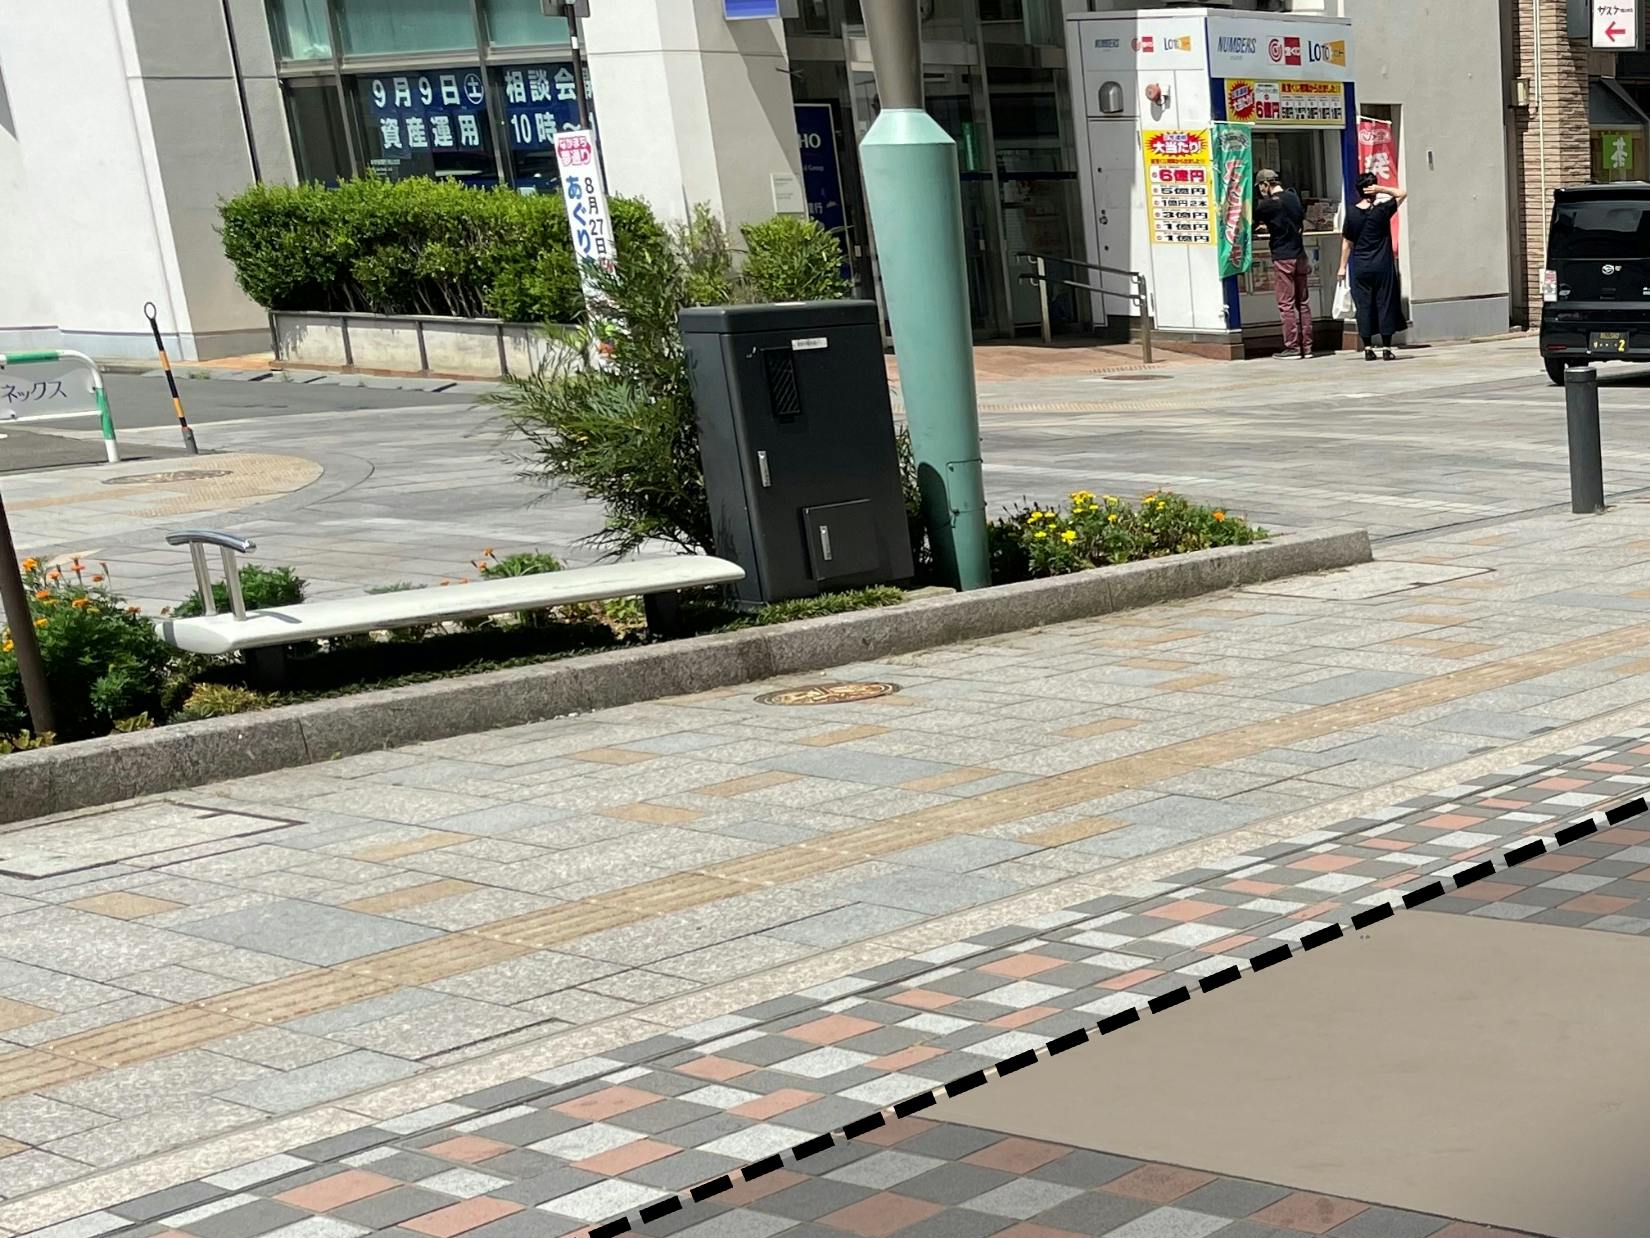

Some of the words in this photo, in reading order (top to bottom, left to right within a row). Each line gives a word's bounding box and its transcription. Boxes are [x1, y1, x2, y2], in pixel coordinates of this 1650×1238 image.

[1217, 36, 1257, 54] NUMBERS
[380, 114, 480, 149] 資産運用
[1159, 169, 1205, 182] 6億円
[566, 175, 595, 265] あぐり
